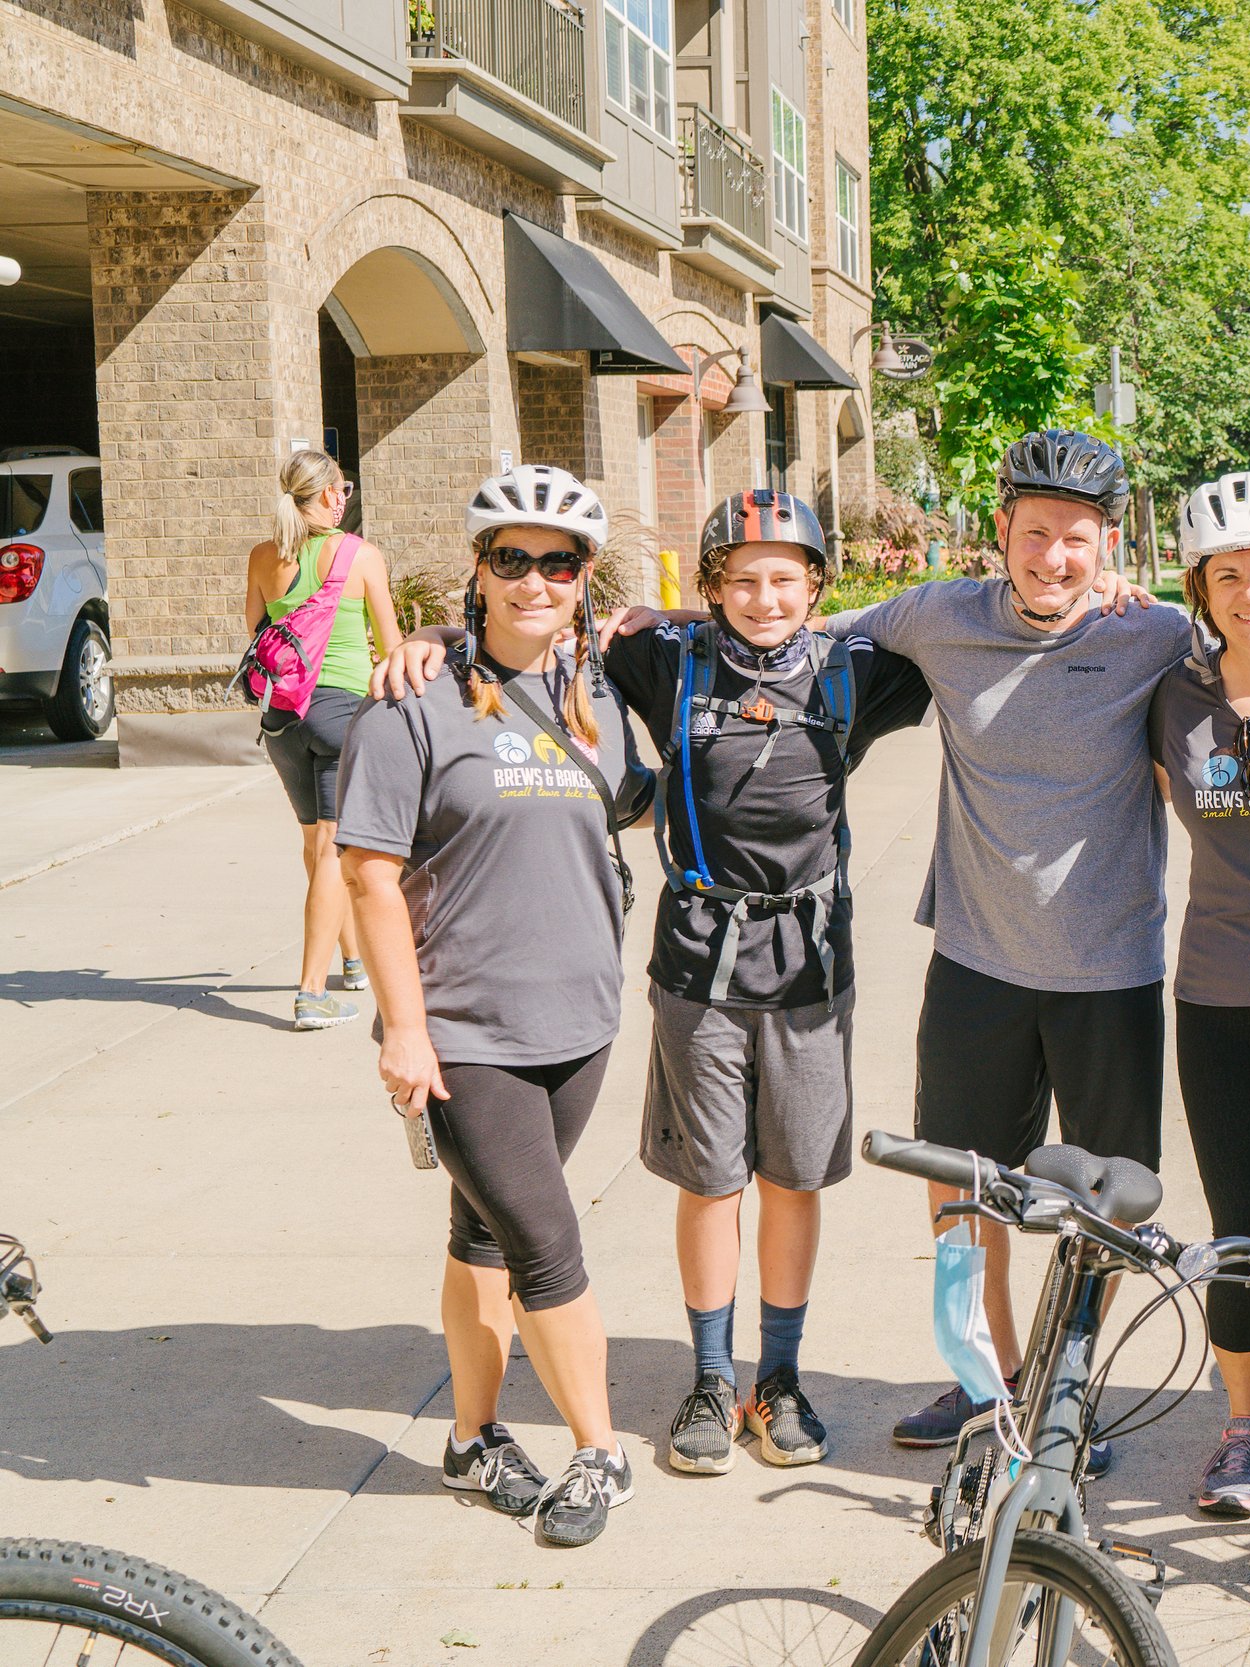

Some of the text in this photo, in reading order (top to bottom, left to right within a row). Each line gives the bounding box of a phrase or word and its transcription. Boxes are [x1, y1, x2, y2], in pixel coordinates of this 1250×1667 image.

[1067, 665, 1106, 674] patagonia
[494, 768, 543, 787] BREWS
[545, 769, 554, 786] &
[499, 786, 602, 801] small town bike tou
[1195, 790, 1243, 809] BREWS
[1202, 807, 1232, 818] small
[102, 1585, 170, 1627] XR2
